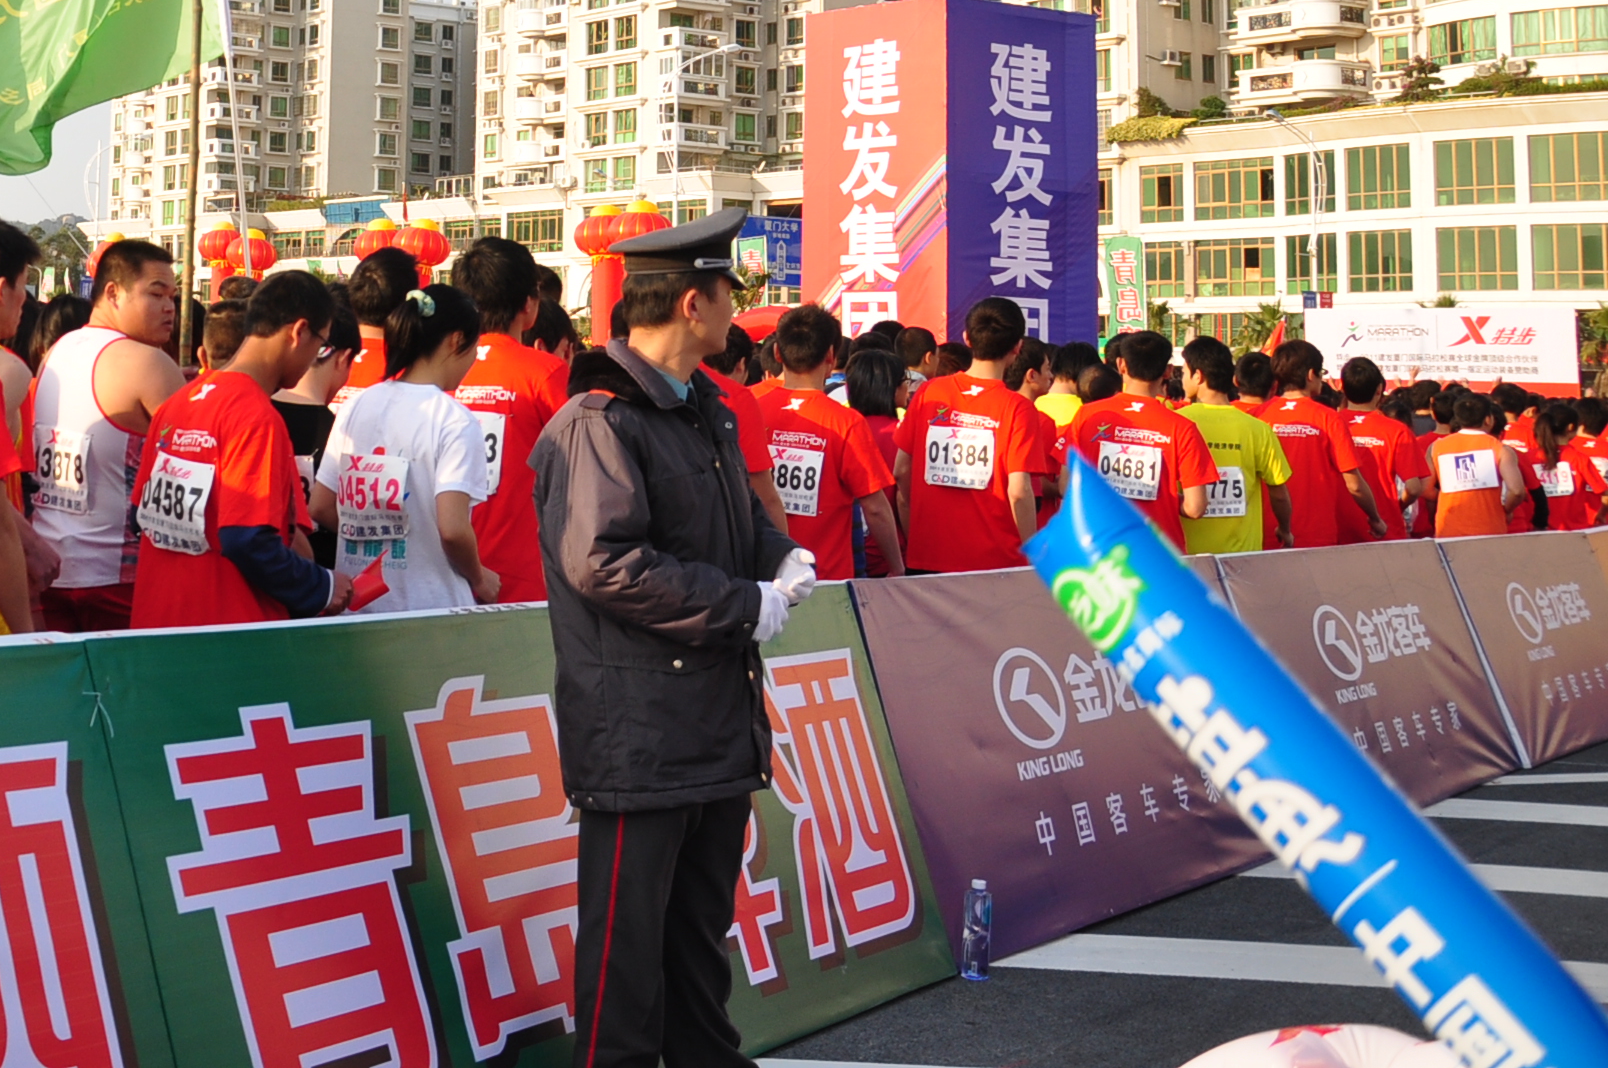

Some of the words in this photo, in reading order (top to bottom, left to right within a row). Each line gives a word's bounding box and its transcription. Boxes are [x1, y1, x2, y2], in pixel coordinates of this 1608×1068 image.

[1366, 327, 1430, 338] MARATHON
[455, 389, 517, 402] MARATHON
[949, 412, 1000, 429] MARATHON
[772, 432, 827, 449] MARATHON
[1114, 429, 1171, 445] MARATHON
[928, 440, 989, 468] 01384
[1100, 454, 1157, 482] 04681
[142, 476, 204, 524] 04587
[337, 474, 401, 512] 04512
[1355, 603, 1433, 664] 金龙客车
[1063, 650, 1149, 724] 金龙
[1335, 687, 1358, 705] KING
[1356, 682, 1378, 701] LONG
[1016, 757, 1050, 782] KING
[1049, 748, 1085, 773] LONG
